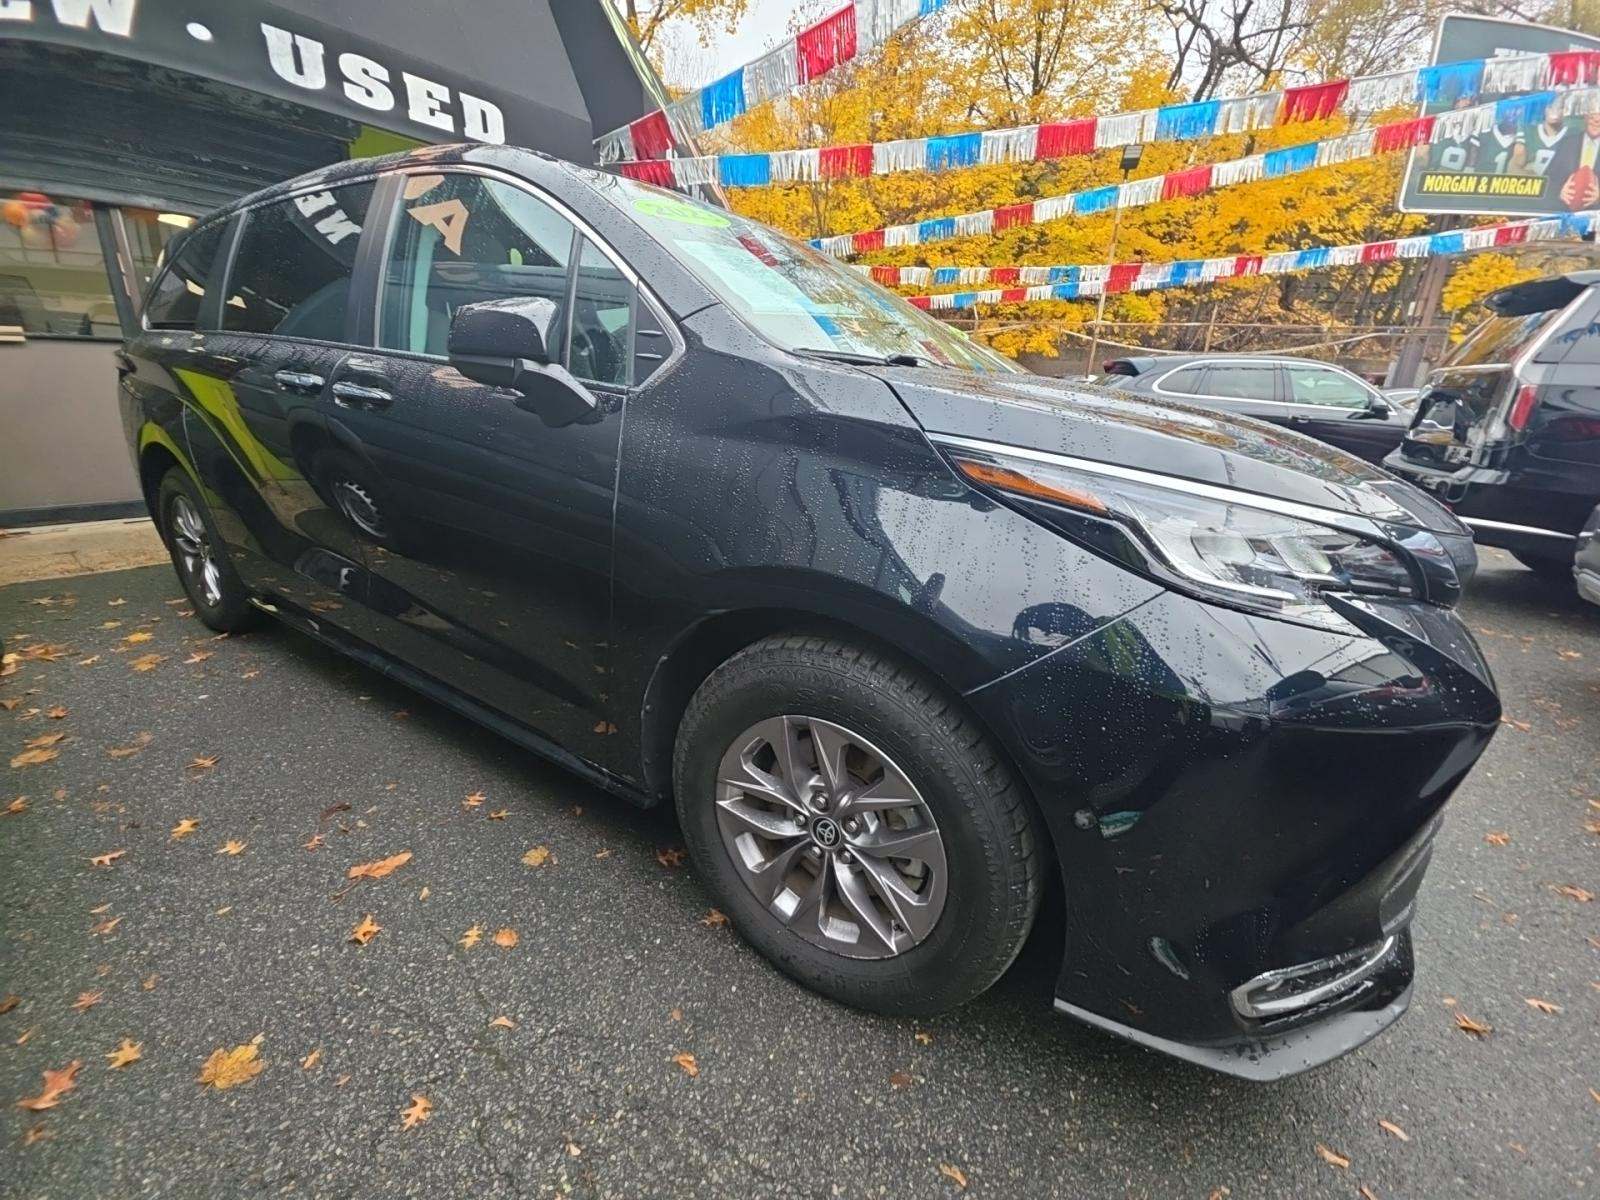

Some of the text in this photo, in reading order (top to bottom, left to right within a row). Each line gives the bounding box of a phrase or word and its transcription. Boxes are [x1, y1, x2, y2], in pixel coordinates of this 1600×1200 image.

[260, 22, 506, 145] USED
[1424, 174, 1542, 196] MORGAN & MORGAN
